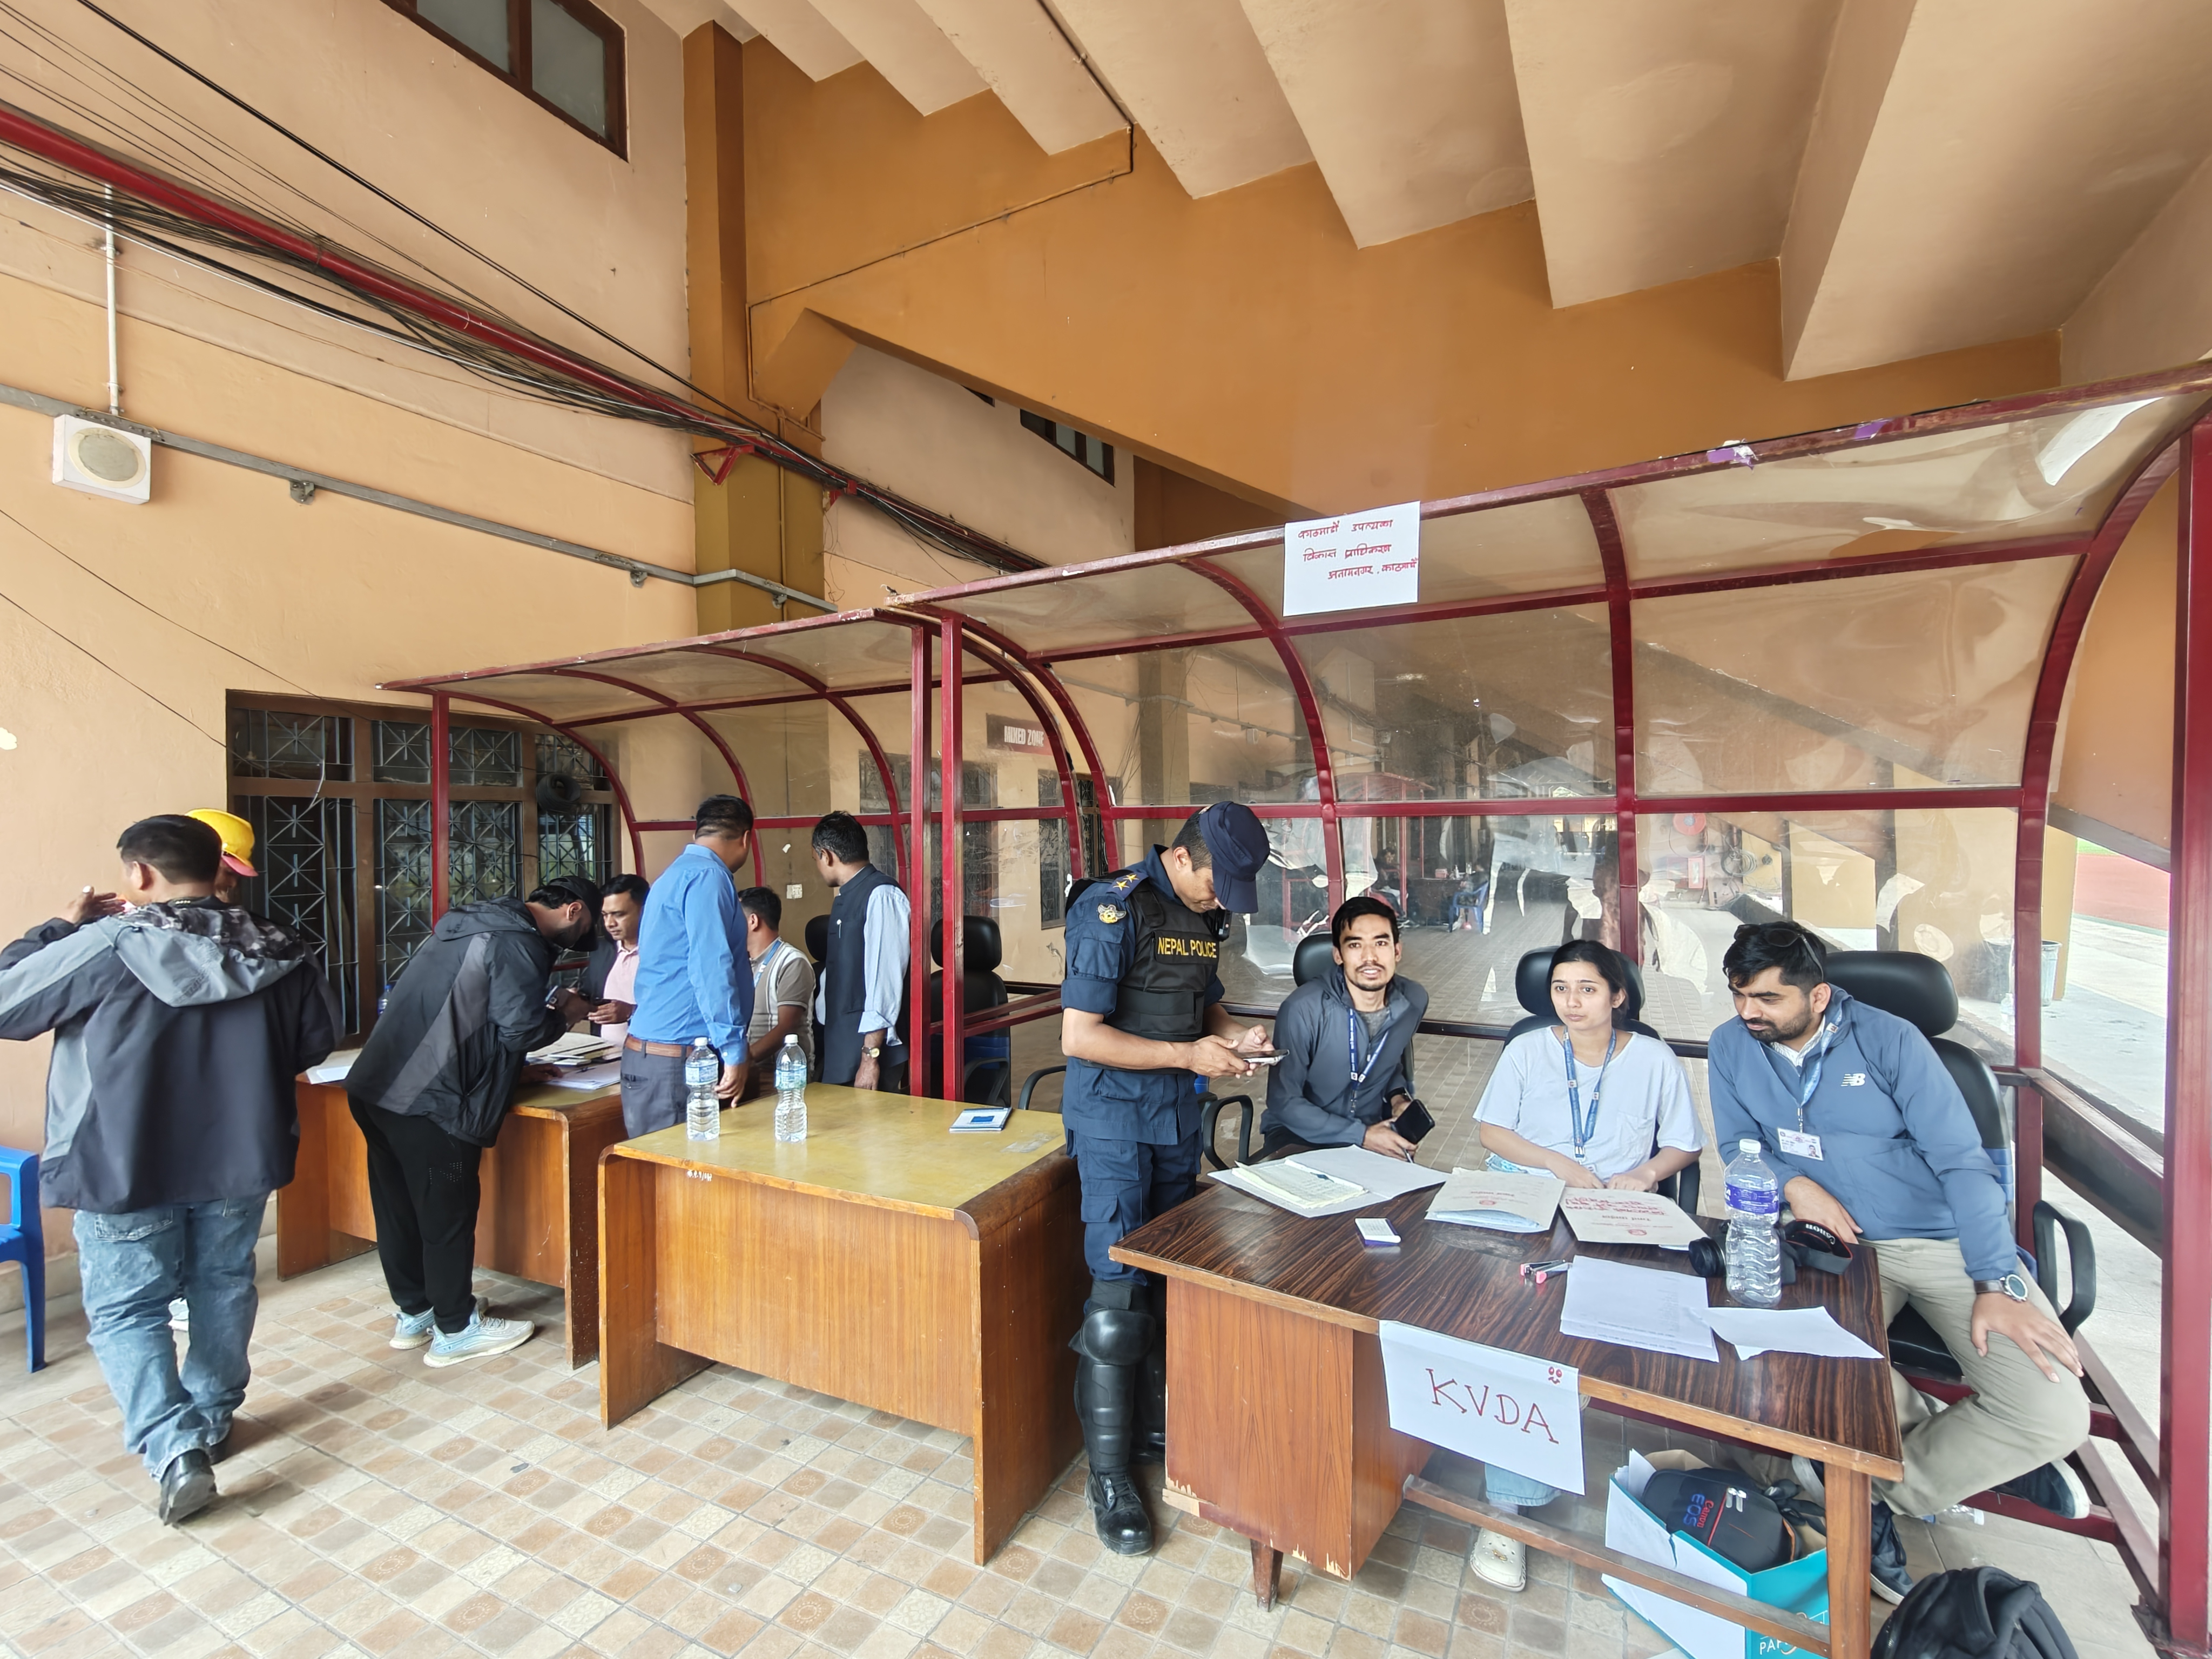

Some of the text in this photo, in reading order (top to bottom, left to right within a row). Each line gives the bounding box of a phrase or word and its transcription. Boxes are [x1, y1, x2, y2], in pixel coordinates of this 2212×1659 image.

[1303, 543, 1392, 562] विकास प्राधिकरण
[1004, 725, 1044, 747] MIXED ZONE
[1157, 937, 1217, 958] NEPAL POLICE
[1805, 1223, 1836, 1245] Canon
[1426, 1368, 1559, 1444] KVDA
[1683, 1493, 1705, 1527] EOS
[1697, 1499, 1714, 1528] Canon
